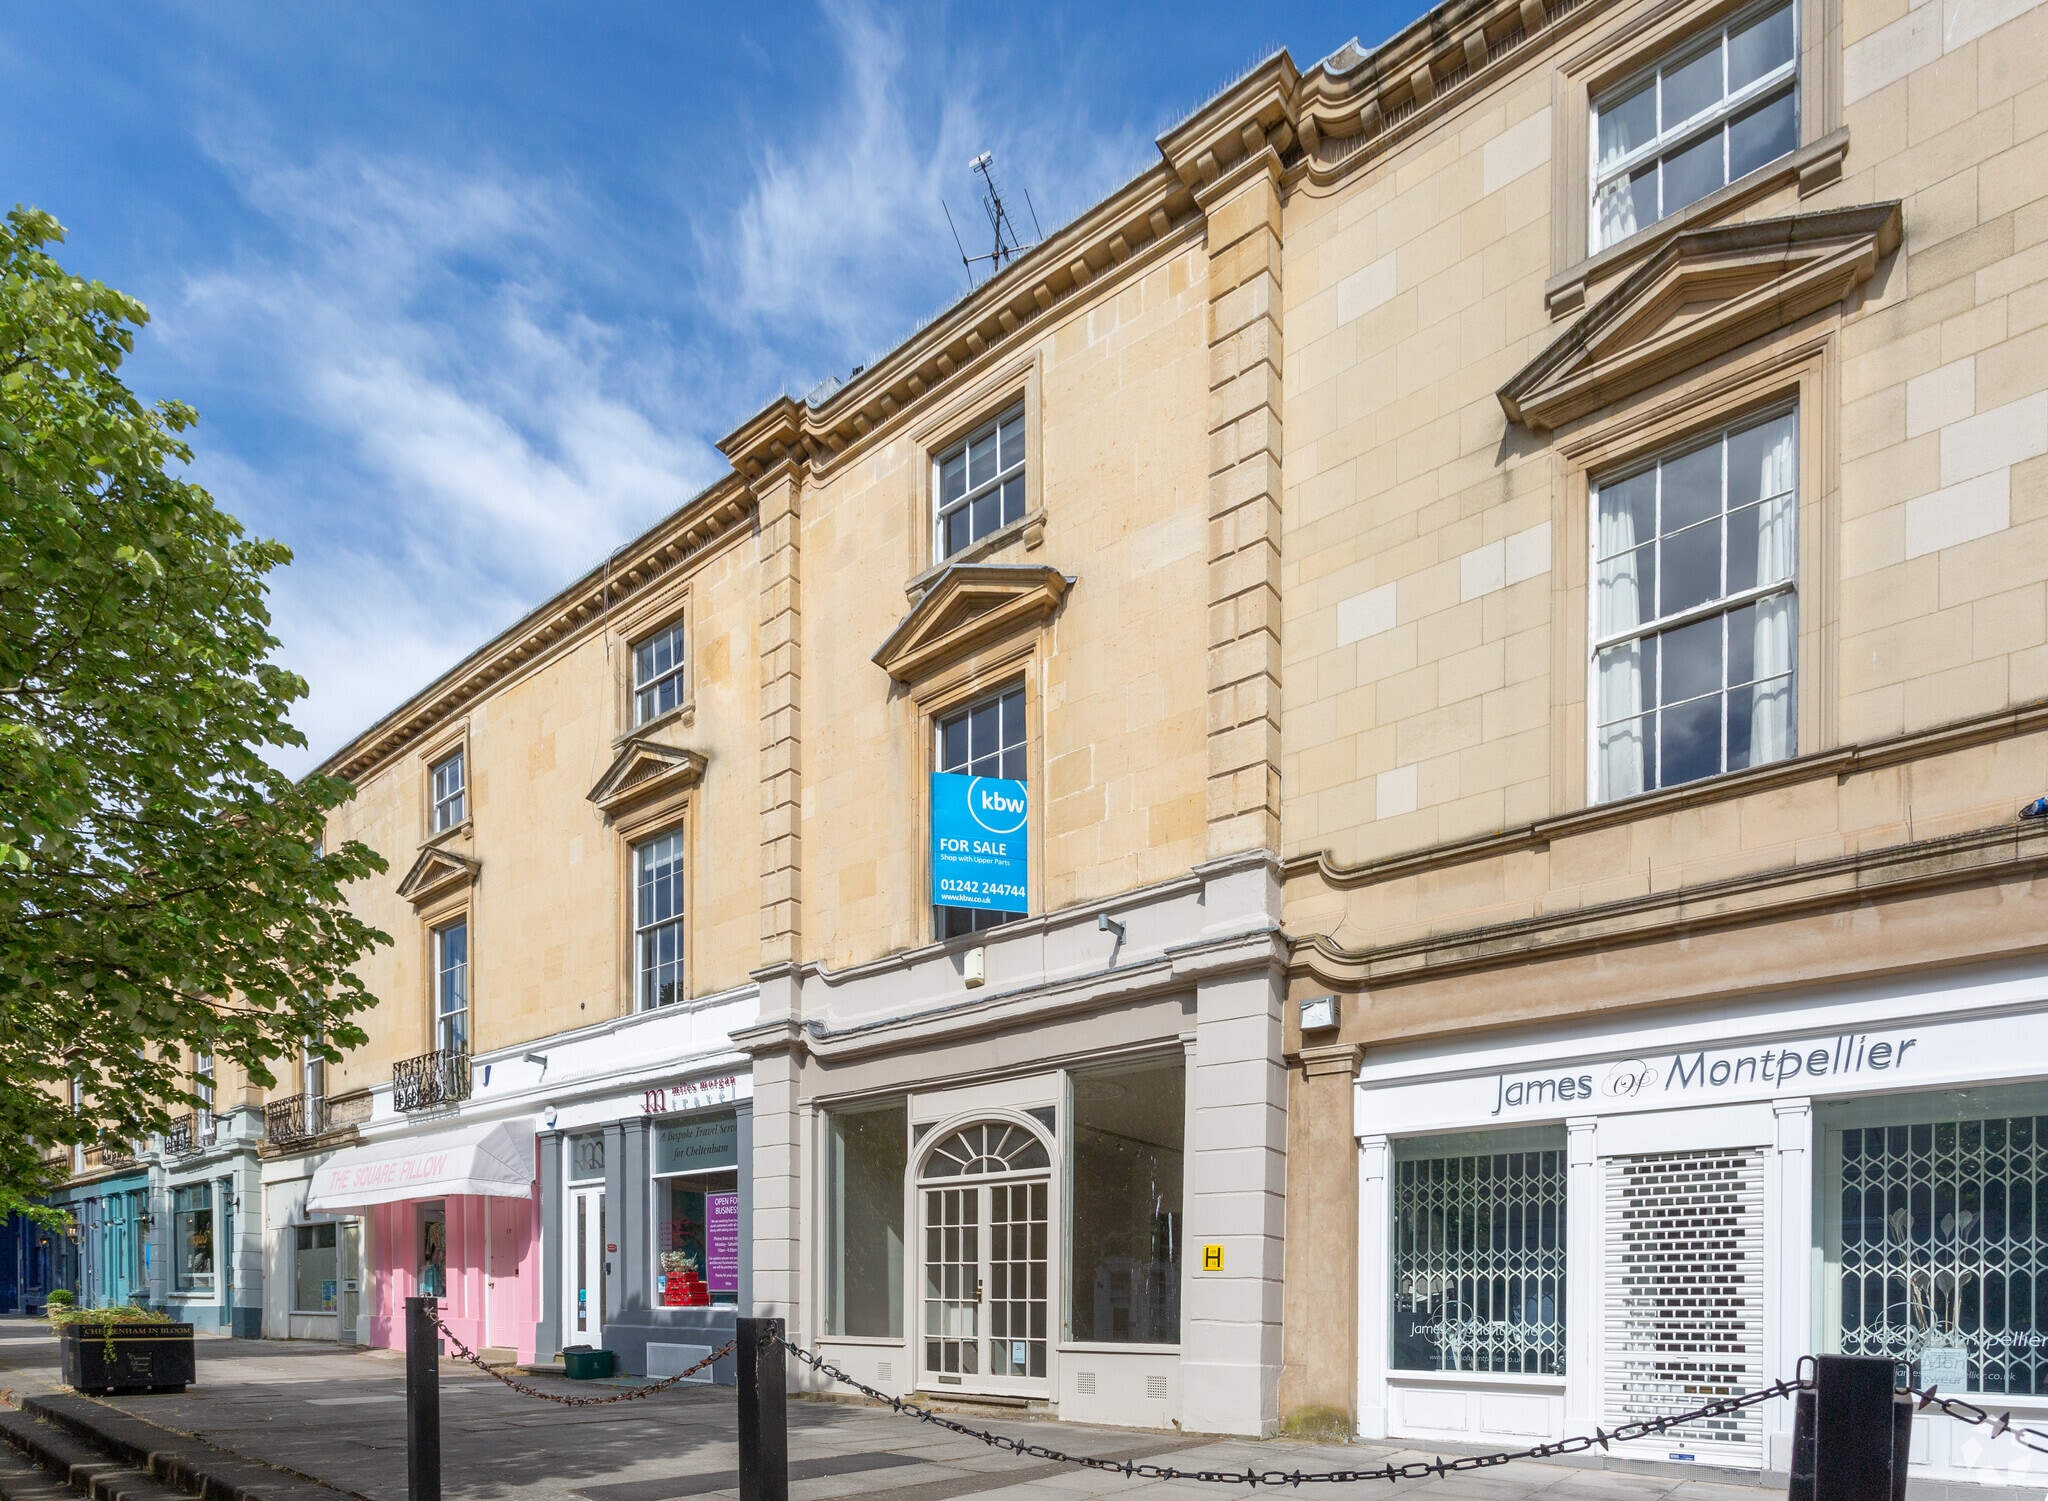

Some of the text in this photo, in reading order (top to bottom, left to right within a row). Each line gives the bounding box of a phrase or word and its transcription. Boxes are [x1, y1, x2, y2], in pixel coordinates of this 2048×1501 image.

[982, 790, 1025, 814] kbw
[940, 838, 1007, 856] FOR SALE
[941, 854, 1011, 866] Shop with Upper Parts
[941, 879, 1026, 898] 01242 244744
[941, 893, 992, 904] www.kbw.co.uk
[1491, 1075, 1593, 1115] James
[1665, 1035, 1917, 1091] Montpellier
[672, 1076, 736, 1096] miles morgan
[672, 1084, 736, 1111] travel
[660, 1131, 666, 1141] A
[667, 1128, 693, 1142] Bespoke
[695, 1124, 718, 1137] Travel
[673, 1143, 729, 1161] for Cheltenham
[330, 1154, 448, 1190] THE SQUARE PILLOW
[714, 1197, 729, 1206] OPEN
[1206, 1247, 1221, 1268] H
[85, 1327, 146, 1335] CHEENHAM
[1409, 1321, 1445, 1338] James
